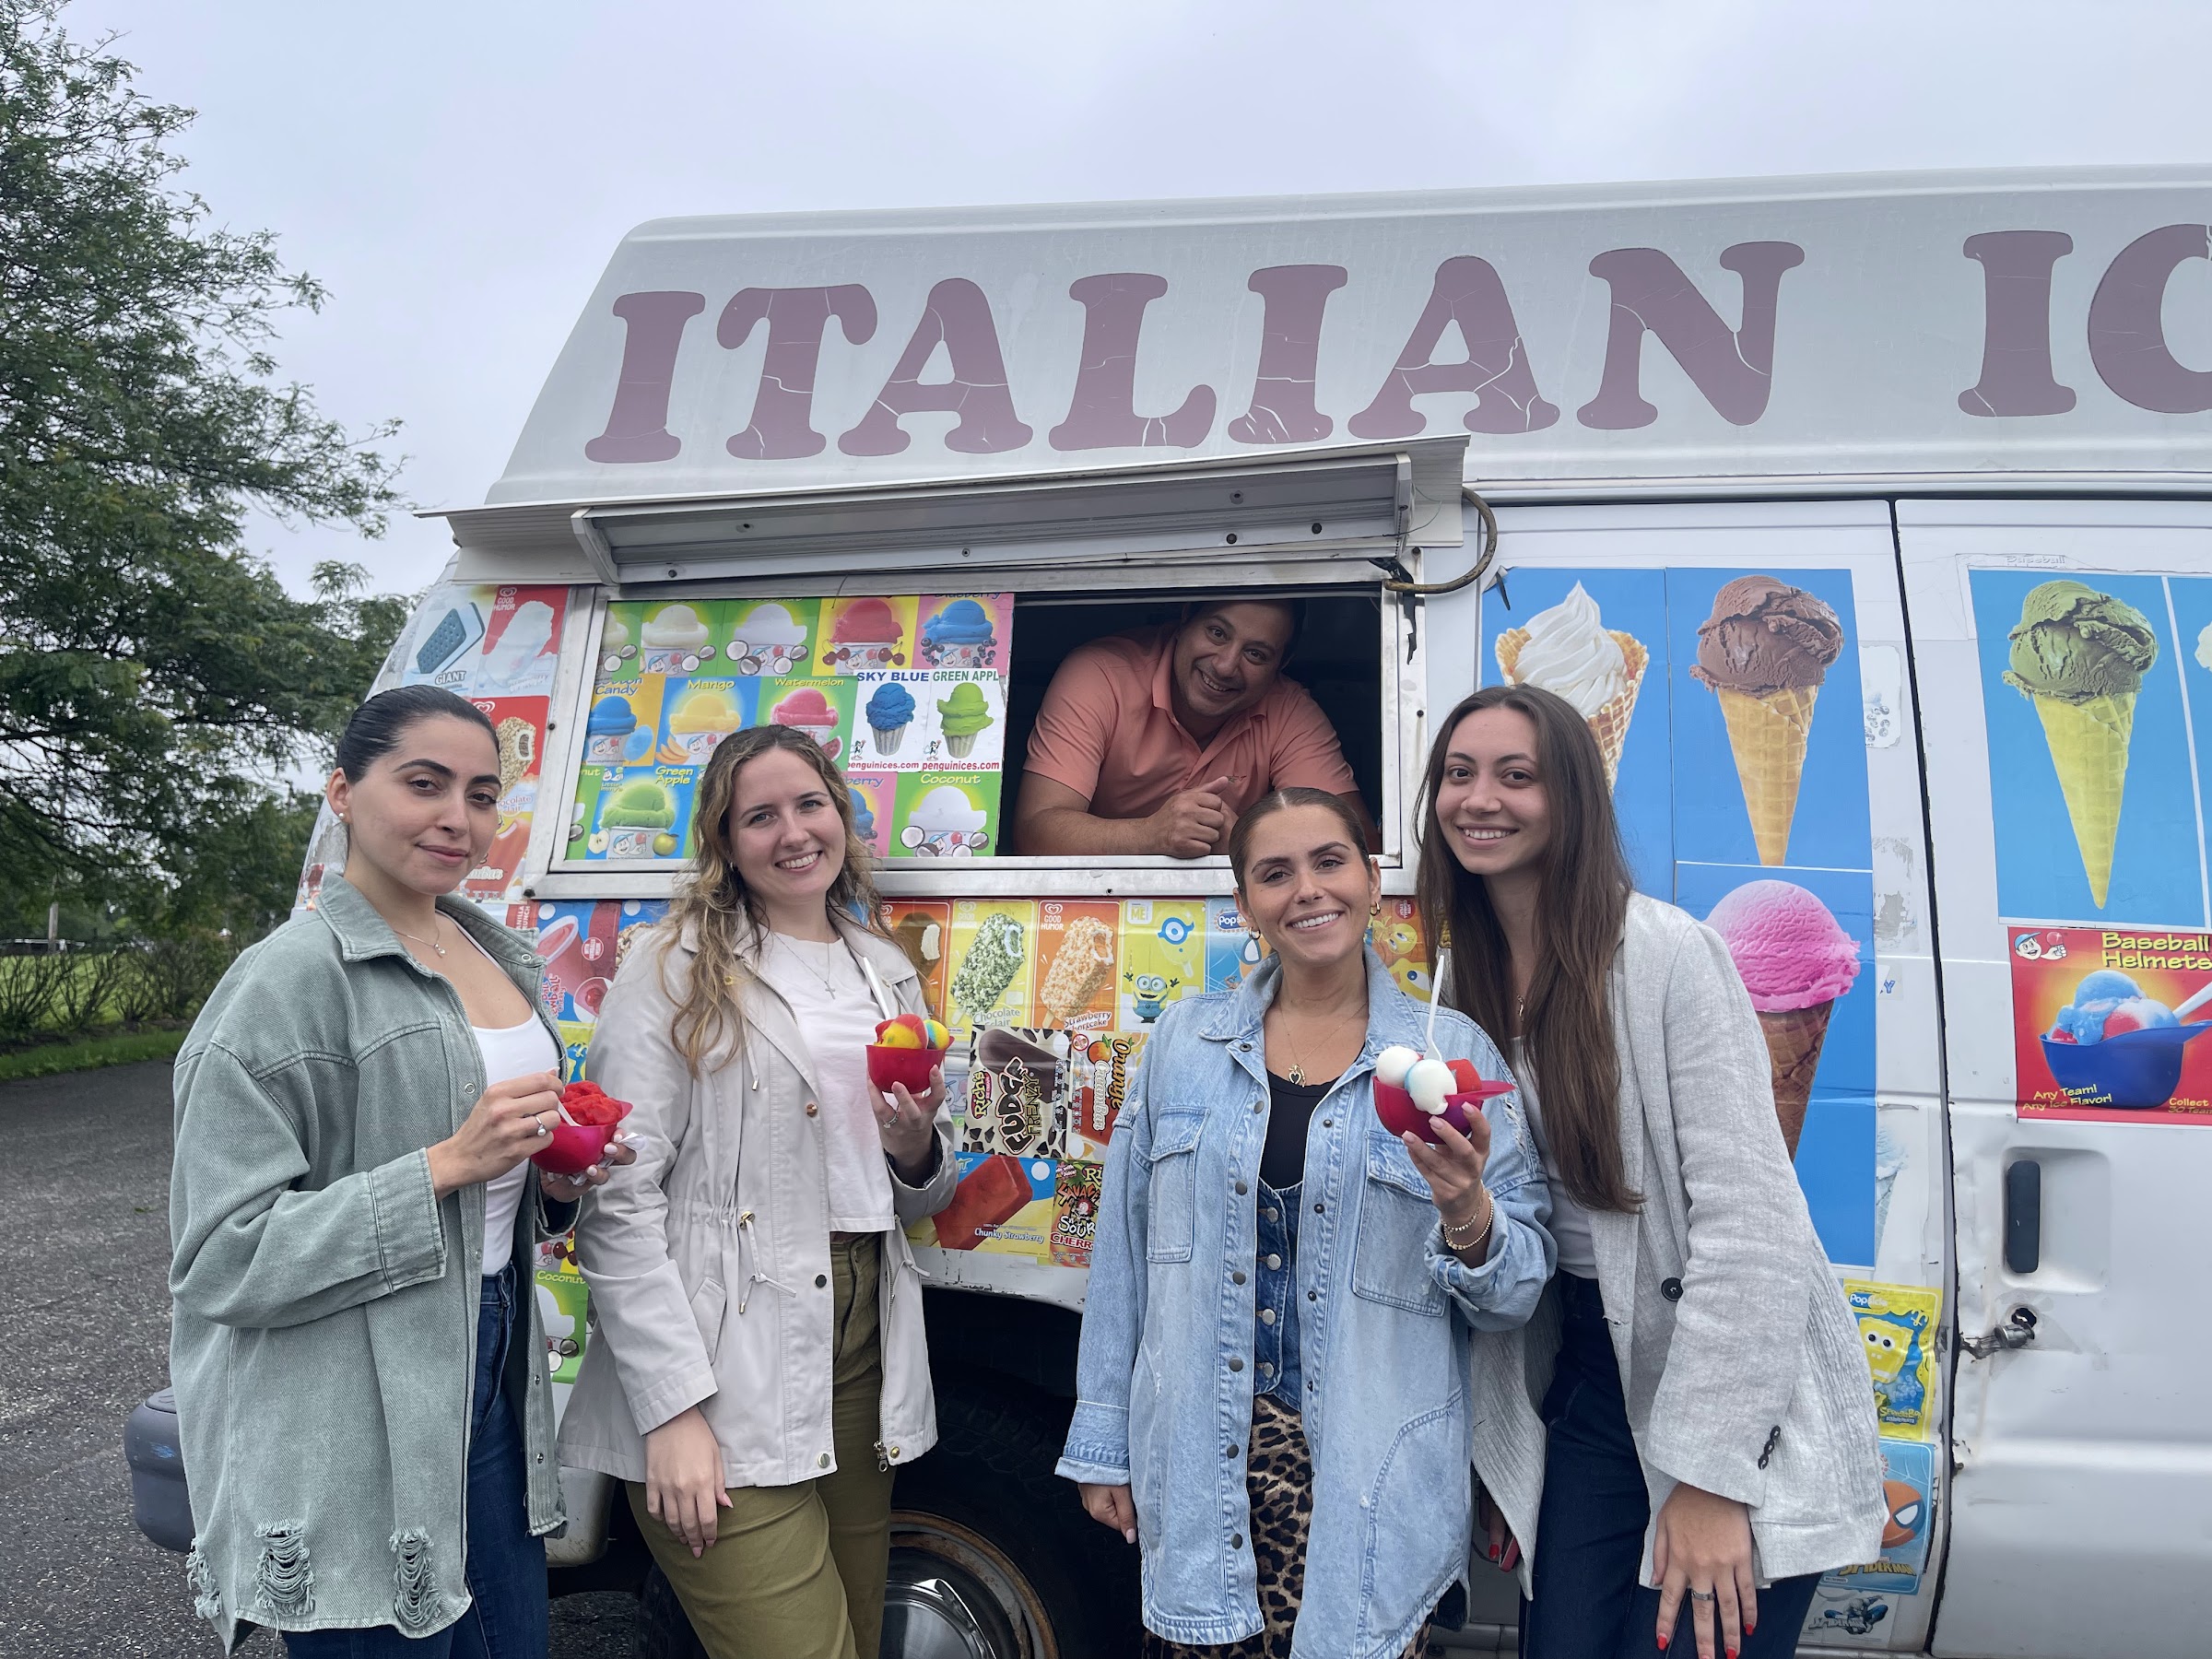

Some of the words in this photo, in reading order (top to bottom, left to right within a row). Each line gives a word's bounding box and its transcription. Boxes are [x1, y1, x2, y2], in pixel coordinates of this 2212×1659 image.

[585, 241, 1805, 464] ITALIAN
[1958, 224, 2212, 418] IC
[435, 670, 466, 686] GIANT
[774, 678, 844, 688] Watermelon
[857, 672, 887, 682] SKY
[890, 672, 930, 682] BLUE
[933, 671, 971, 681] GREEN
[972, 671, 999, 681] APPL
[595, 685, 638, 696] Candy
[688, 678, 735, 690] Mango
[655, 766, 694, 776] Green
[922, 761, 1000, 771] penguinices.com
[655, 775, 691, 787] Apple
[844, 776, 884, 787] berry
[920, 774, 981, 784] Coconut
[523, 906, 531, 929] RUNCH
[1043, 914, 1062, 924] GOOD
[1131, 906, 1147, 921] ME
[1041, 924, 1065, 932] HUMOR
[2101, 932, 2210, 952] Baseball
[2101, 950, 2212, 970] Helmets
[973, 1007, 1020, 1024] Chocolate
[1064, 1011, 1112, 1028] Strawberry
[1069, 1018, 1107, 1030] hortcake
[1108, 1039, 1132, 1110] Orange
[971, 1070, 993, 1117] Rich's
[2033, 1090, 2058, 1102] Any
[2060, 1084, 2098, 1099] Team!
[995, 1056, 1035, 1155] FUDGE
[1021, 1071, 1042, 1136] FRENZY
[2022, 1102, 2046, 1112] Any
[2050, 1100, 2067, 1109] Ice
[2070, 1093, 2112, 1107] Flavor!
[2169, 1098, 2209, 1107] Collect
[1058, 1215, 1096, 1238] SOUR
[974, 1228, 1003, 1241] Chunky
[1004, 1230, 1045, 1244] Strawberry
[1051, 1232, 1094, 1251] CHERR
[536, 1270, 586, 1284] Coconut
